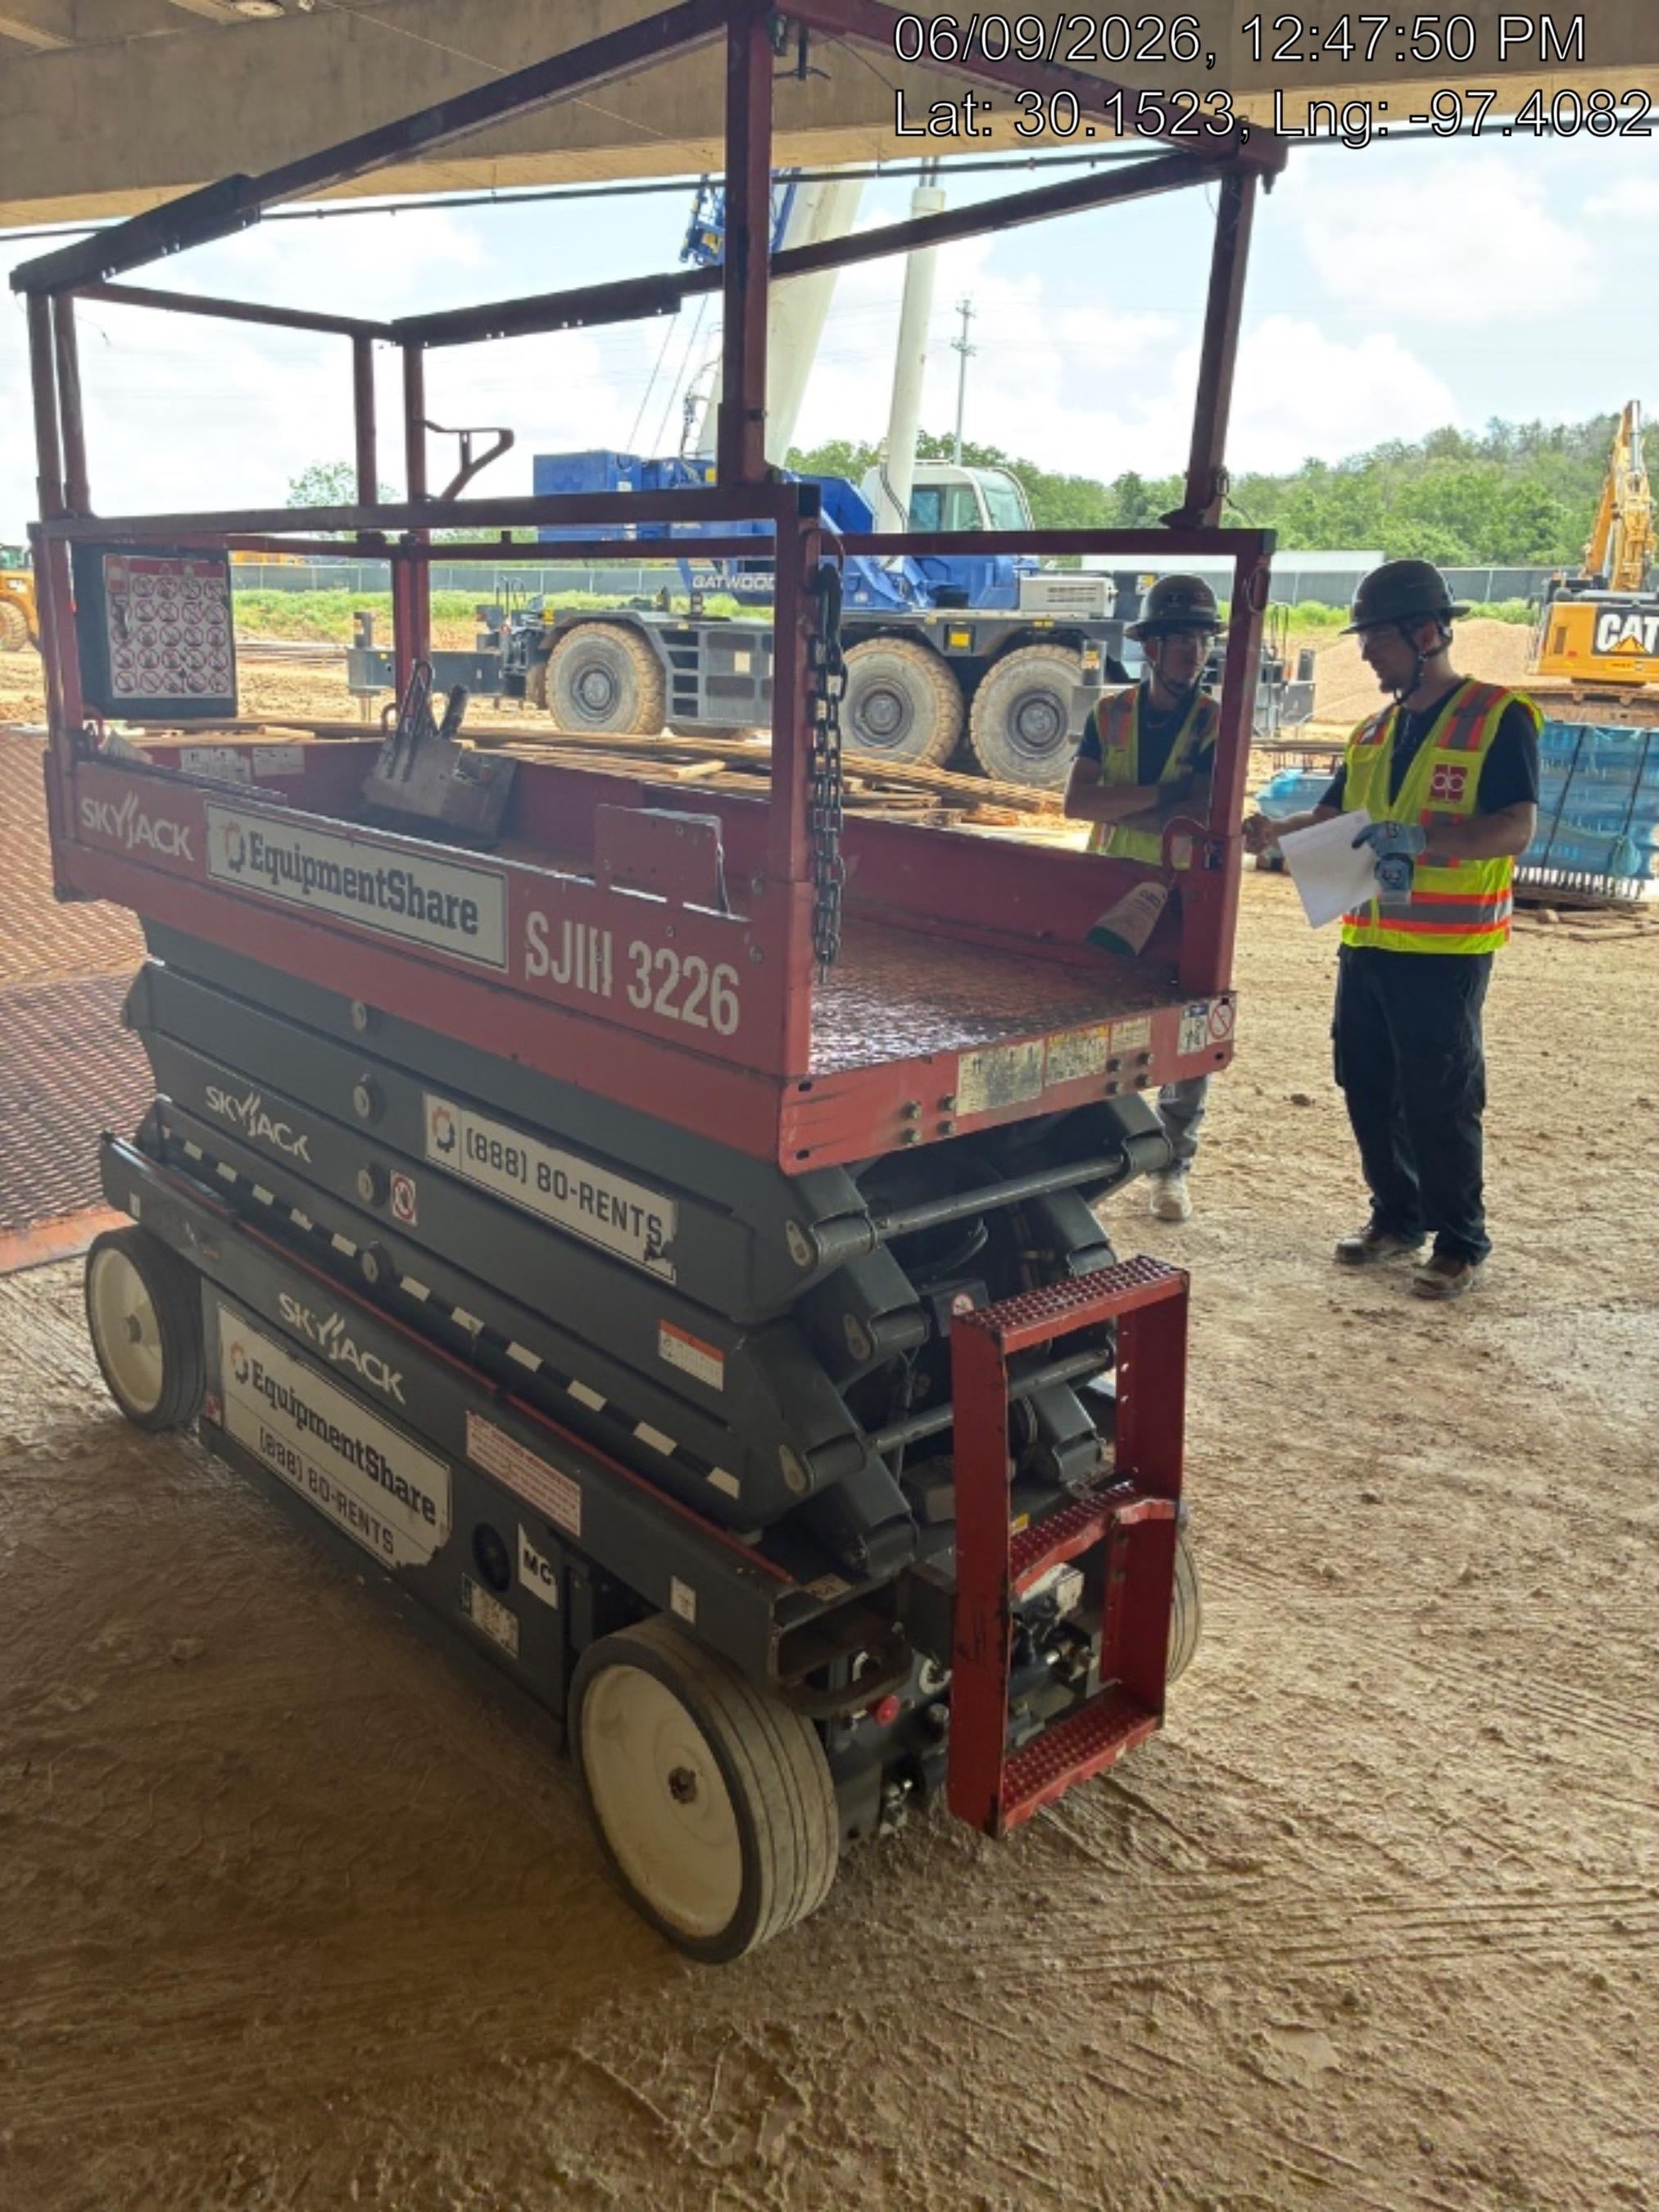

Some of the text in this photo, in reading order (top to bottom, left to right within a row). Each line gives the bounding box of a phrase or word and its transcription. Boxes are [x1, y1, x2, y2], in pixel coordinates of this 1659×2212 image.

[1596, 613, 1659, 655] CAT
[81, 791, 195, 861] SKYJACK
[249, 831, 478, 936] EquipmentShare
[627, 940, 741, 1036] 3226
[205, 1085, 311, 1163] SKYJACK
[465, 1126, 664, 1249] (888) 80-RENTS
[278, 1292, 406, 1405] SKYJACK
[250, 1354, 437, 1526] EquipmentShare
[258, 1425, 305, 1488] (888)
[308, 1463, 395, 1556] 80-RENTS
